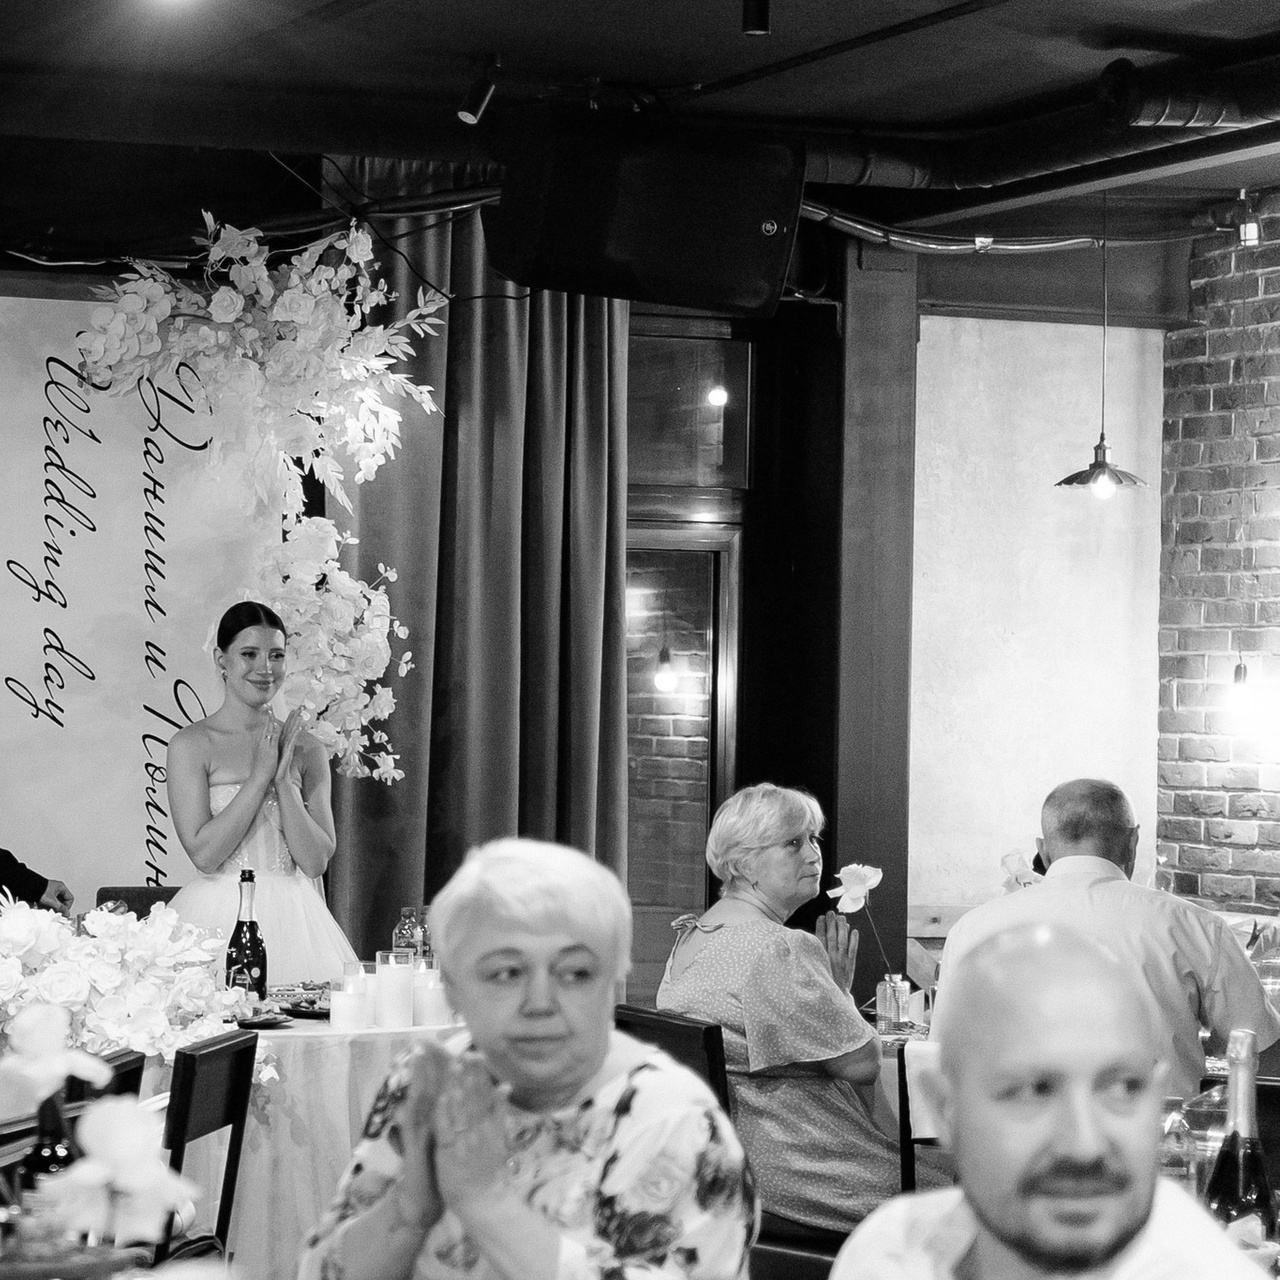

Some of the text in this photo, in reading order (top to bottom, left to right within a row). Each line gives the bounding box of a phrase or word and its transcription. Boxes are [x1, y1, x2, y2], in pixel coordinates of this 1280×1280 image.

[4, 330, 113, 728] Wedding day
[137, 361, 213, 888] Даниил и Полин
